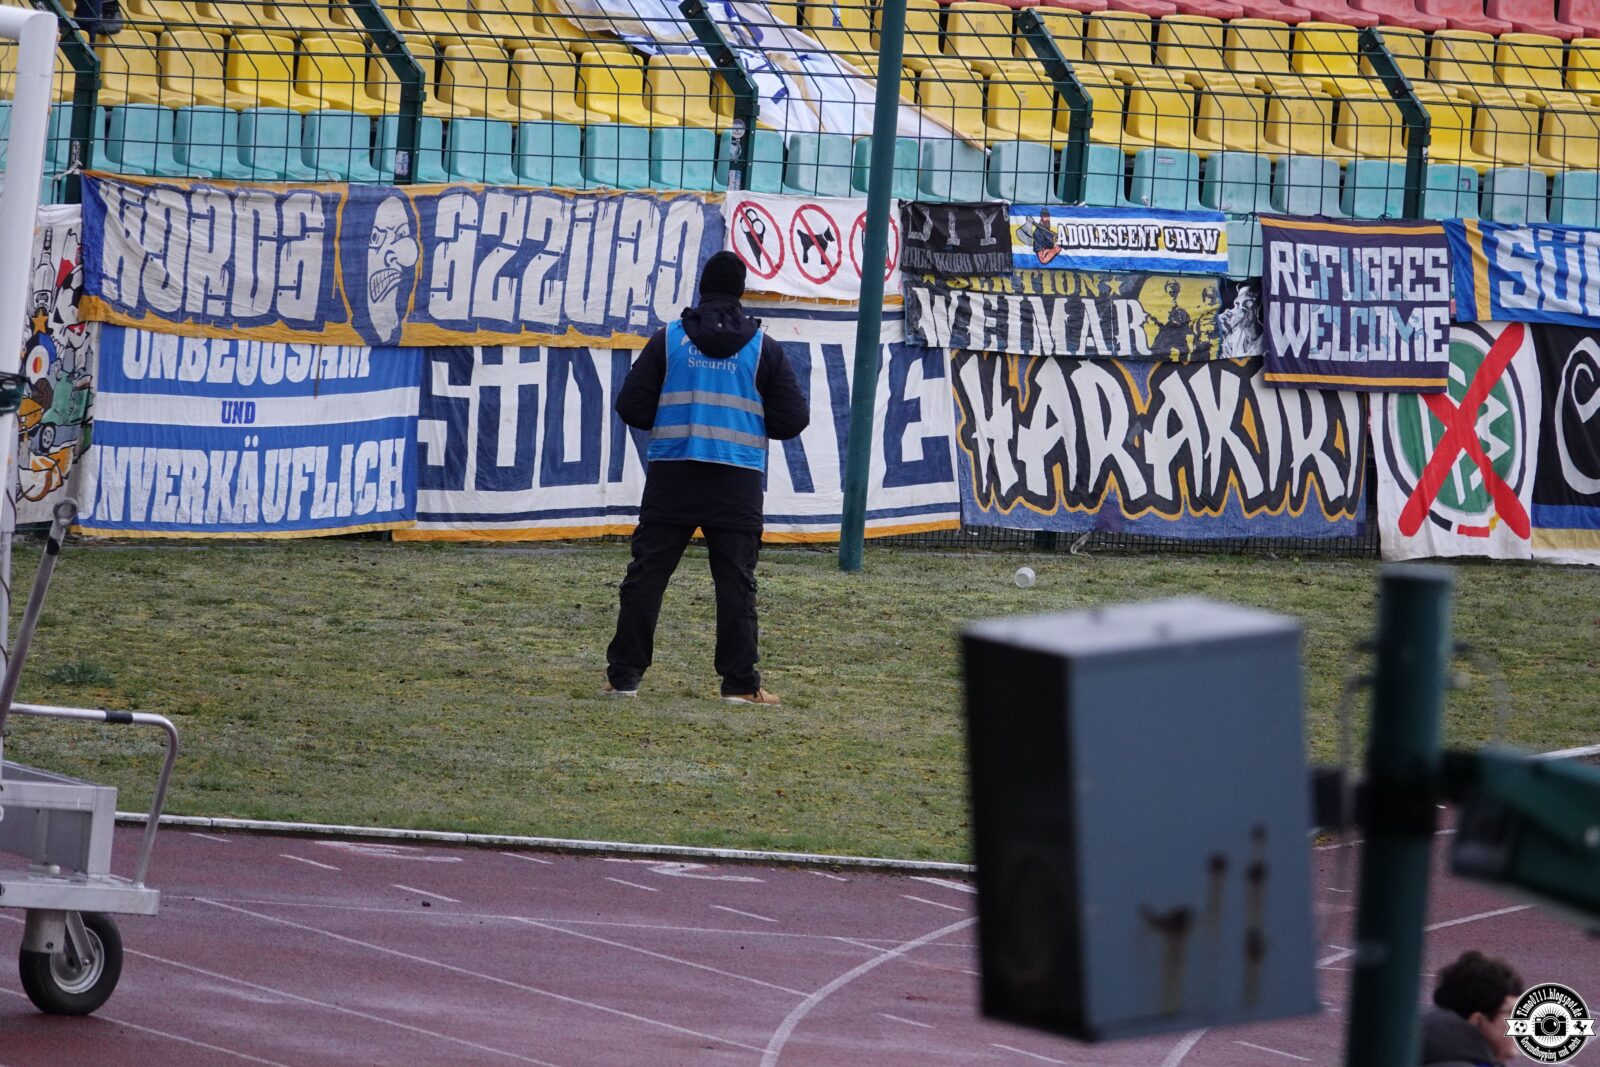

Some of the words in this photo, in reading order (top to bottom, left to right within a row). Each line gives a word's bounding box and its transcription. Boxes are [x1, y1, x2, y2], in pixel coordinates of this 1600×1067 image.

[1057, 224, 1160, 250] ADOLESCENT
[1163, 227, 1219, 254] CREW
[1270, 241, 1449, 302] REFUGEES
[912, 287, 1154, 356] WEIMAR
[1269, 301, 1450, 362] WELCOME
[688, 357, 738, 374] Security
[221, 401, 256, 424] UND
